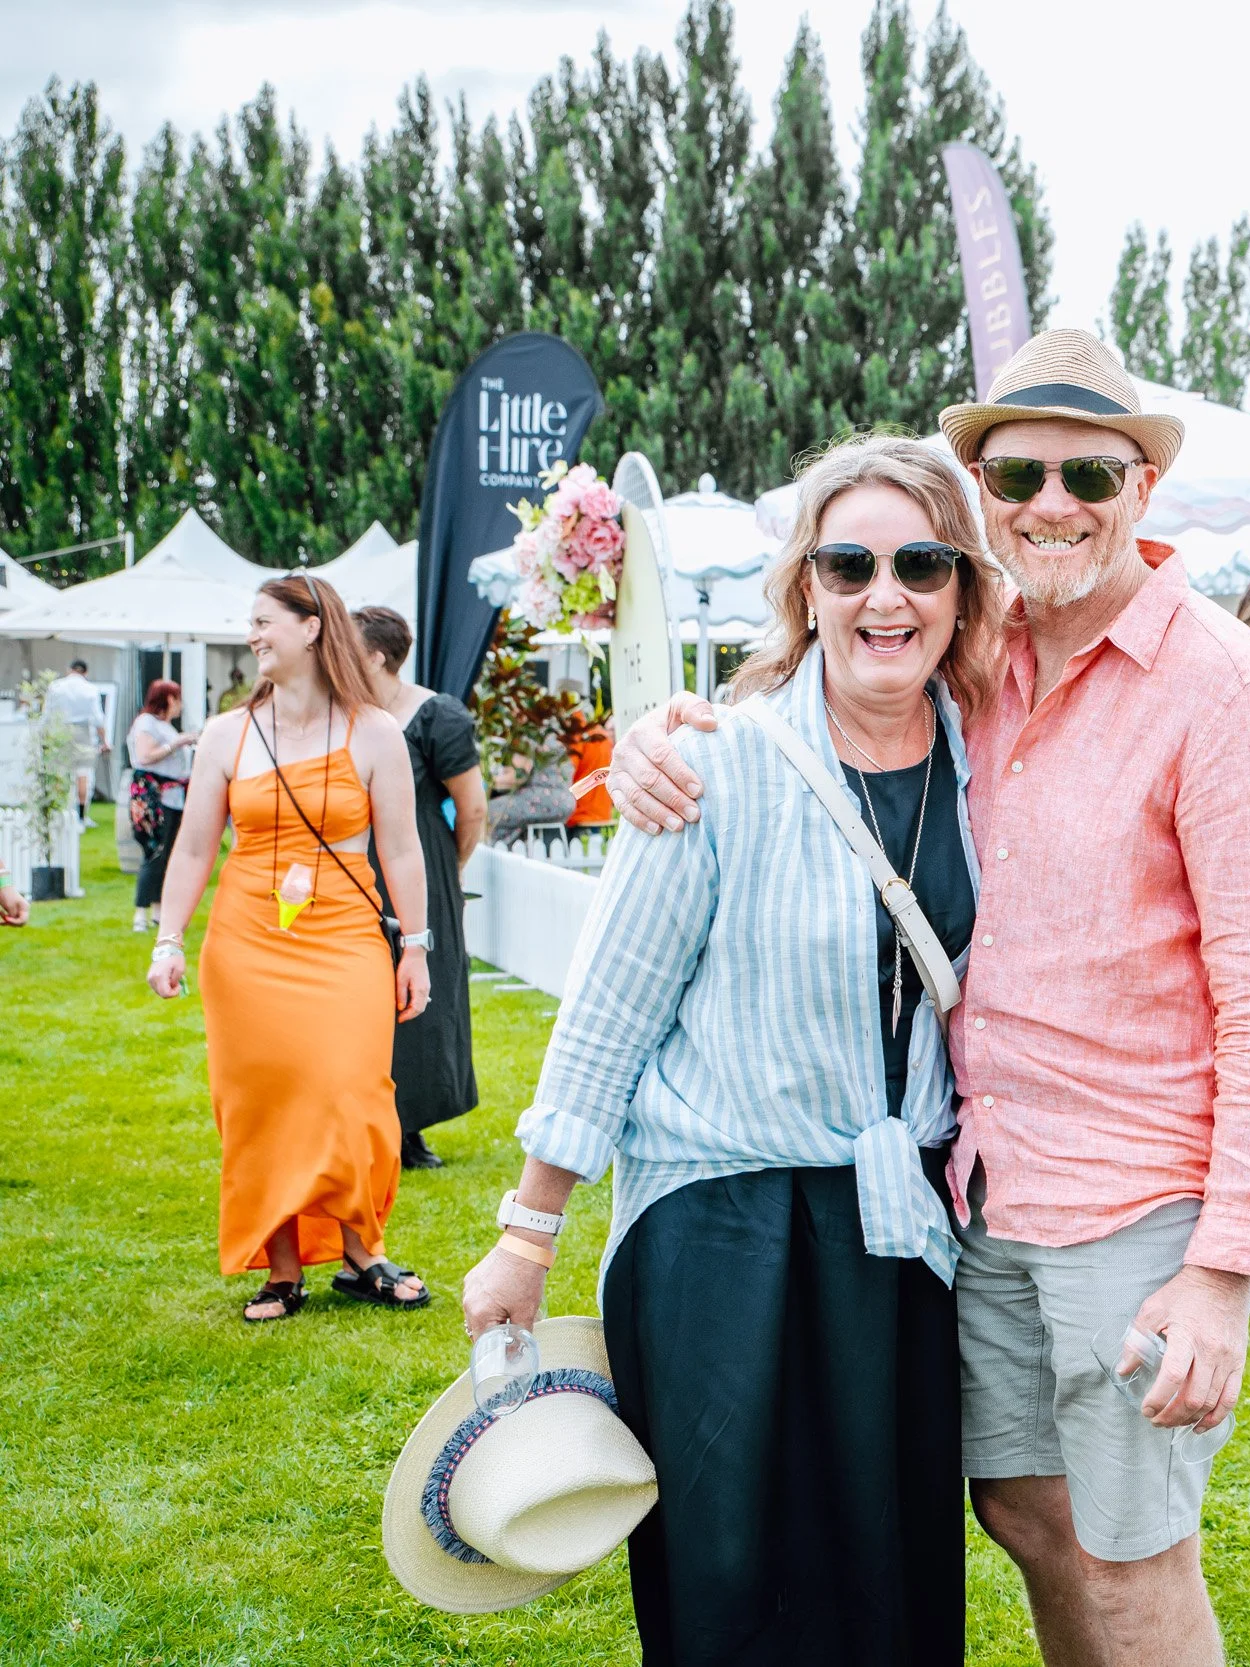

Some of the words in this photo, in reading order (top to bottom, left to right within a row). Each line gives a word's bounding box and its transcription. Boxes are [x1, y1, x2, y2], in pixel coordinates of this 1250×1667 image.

[481, 377, 504, 391] THE
[479, 390, 567, 436] Little
[479, 435, 563, 473] Hire
[479, 473, 541, 488] COMPANY
